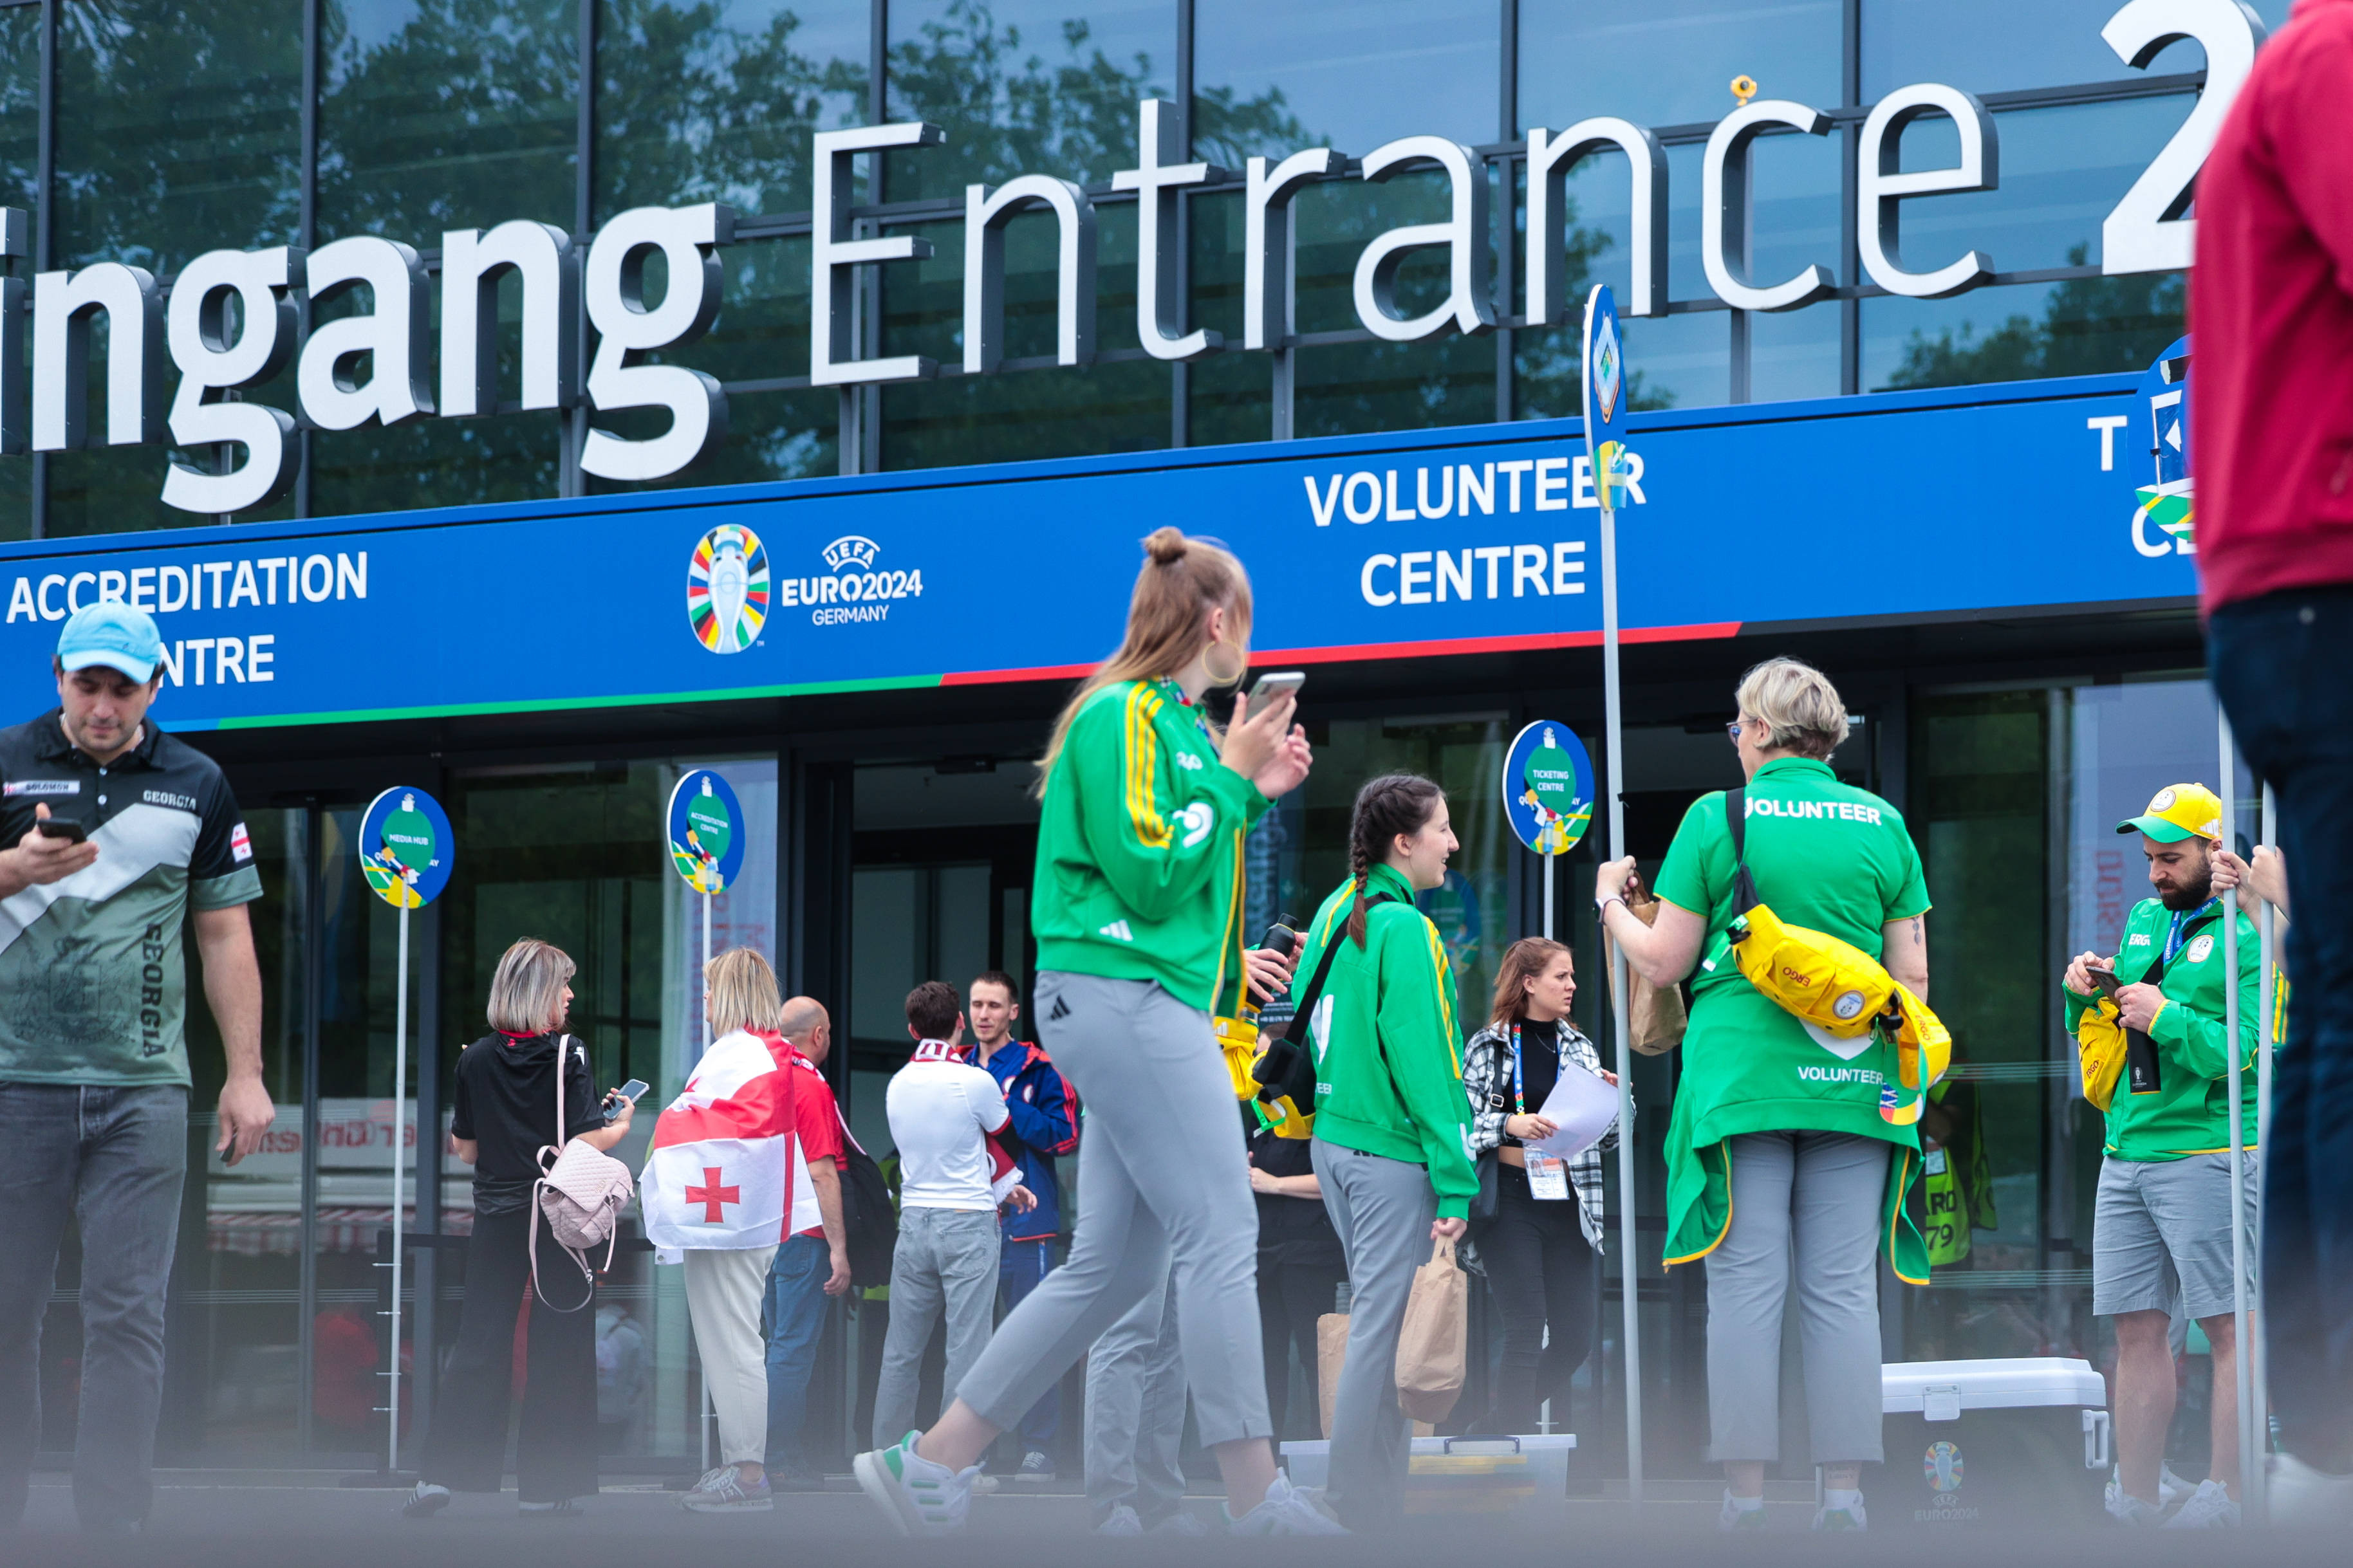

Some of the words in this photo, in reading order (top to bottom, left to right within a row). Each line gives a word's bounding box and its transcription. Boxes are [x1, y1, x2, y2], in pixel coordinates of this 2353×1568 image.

[0, 202, 720, 513] ngang
[811, 82, 1987, 386] Entrance
[2101, 0, 2256, 275] 2
[1304, 452, 1646, 527] VOLUNTEER
[824, 542, 875, 567] UEFA
[1361, 540, 1585, 607] CENTRE
[6, 551, 367, 624] ACCREDITATION
[781, 569, 924, 607] EURO2024
[812, 604, 890, 625] GERMANY
[159, 634, 275, 688] NTRE
[1532, 769, 1569, 780] TICKETING
[1537, 782, 1565, 792] CENTRE
[143, 789, 197, 809] GEORGIA
[389, 833, 413, 844] MEDIA
[413, 836, 429, 846] HUB
[1782, 966, 1811, 988] ERGO
[140, 923, 167, 1058] GEORGIA
[1914, 1014, 1931, 1042] ERGO
[1798, 1065, 1885, 1085] VOLUNTEER
